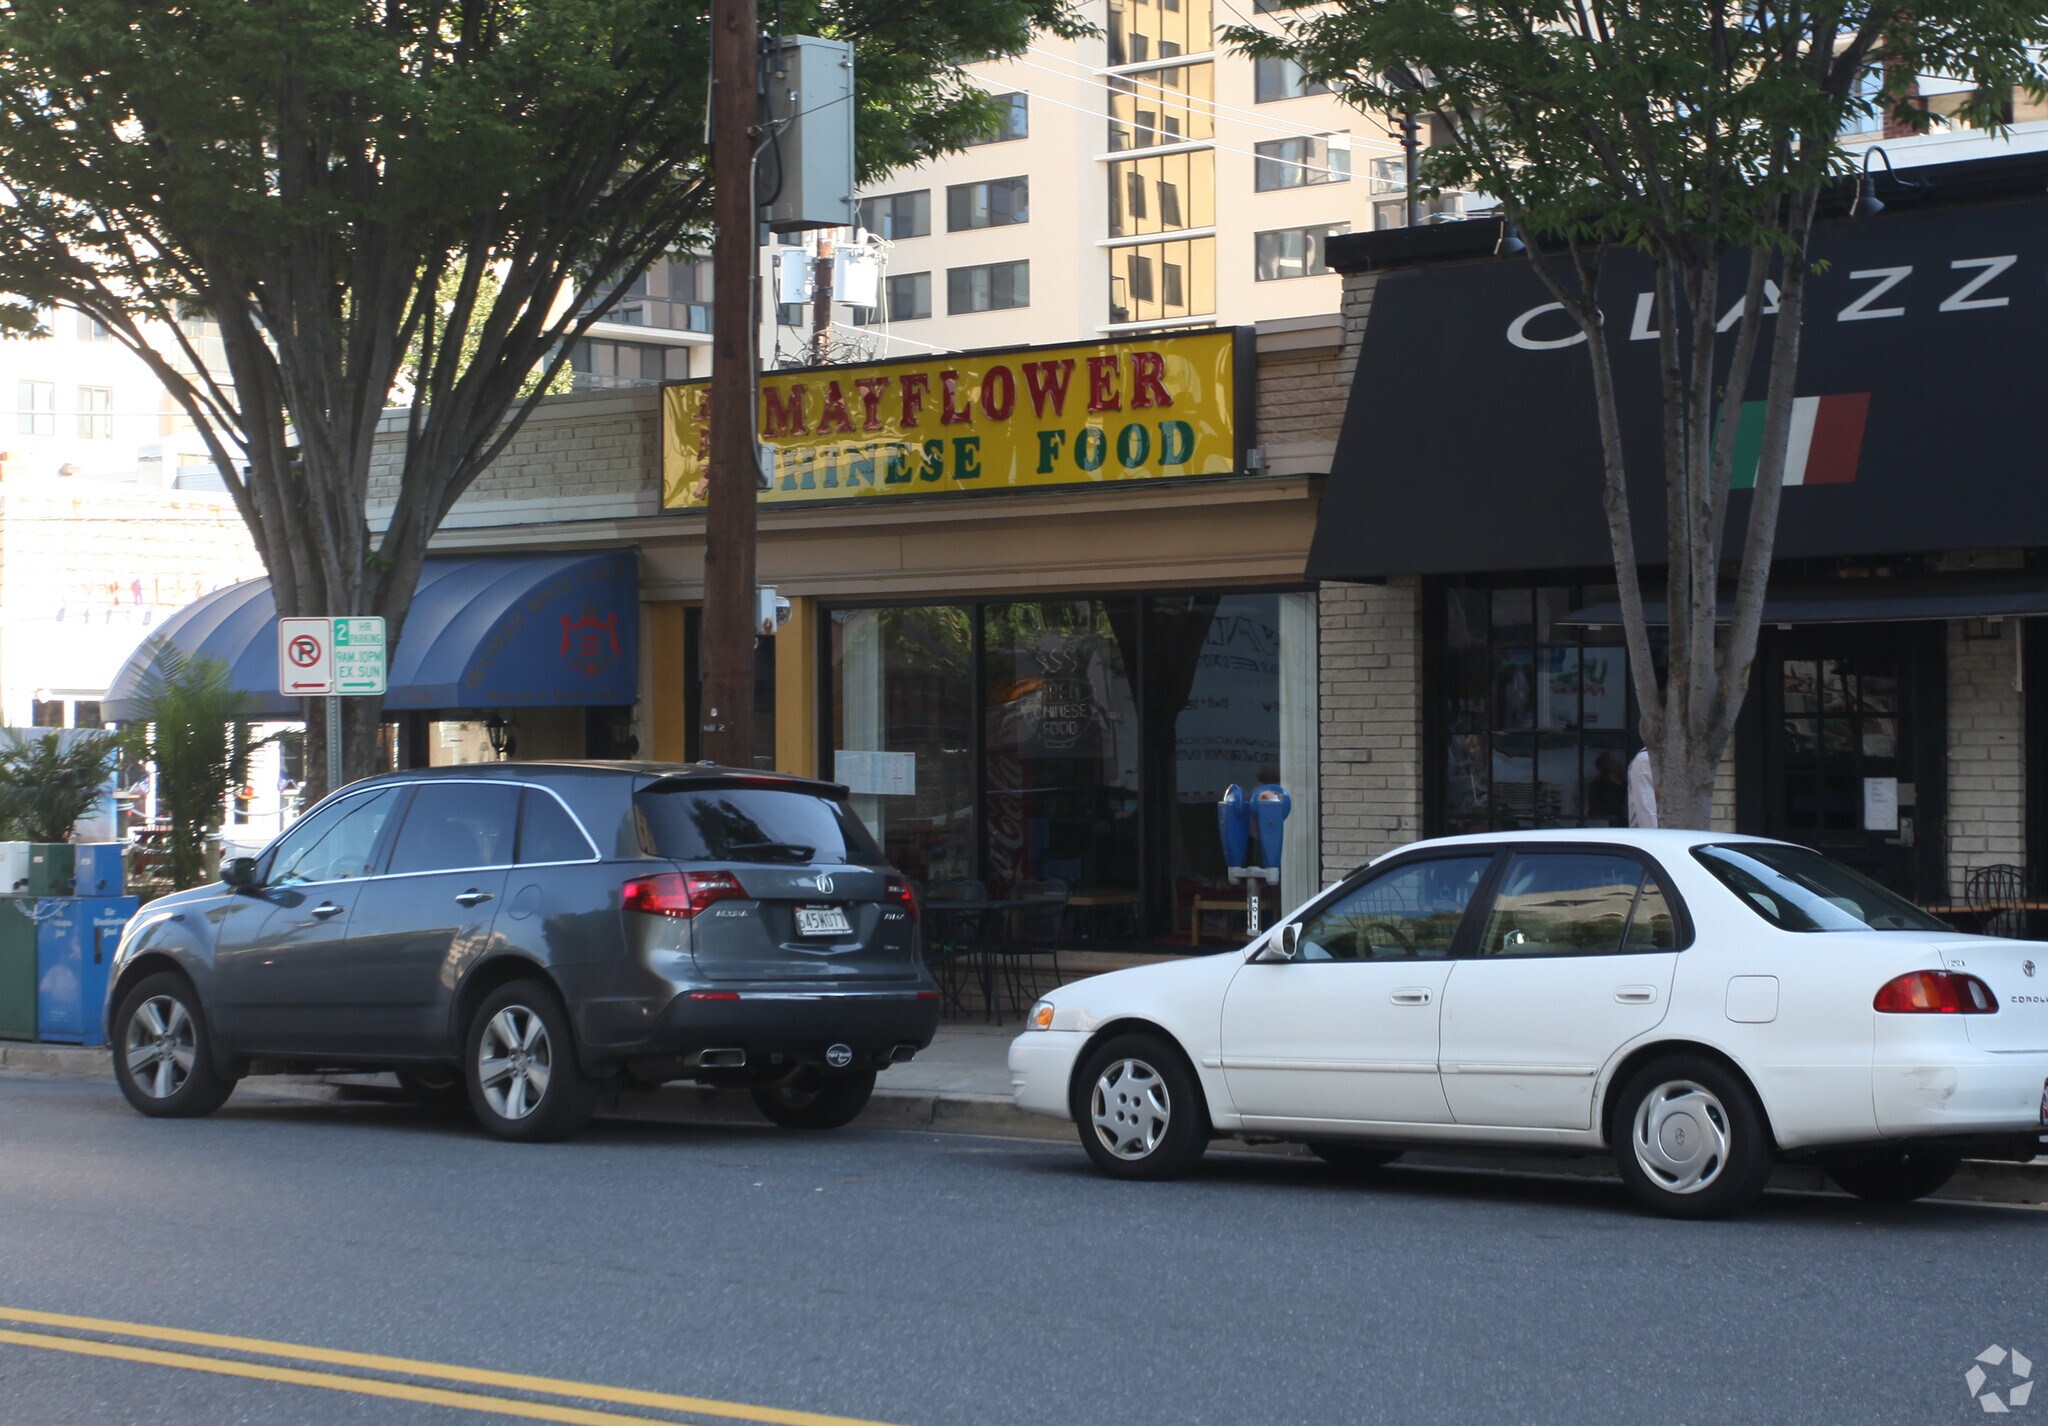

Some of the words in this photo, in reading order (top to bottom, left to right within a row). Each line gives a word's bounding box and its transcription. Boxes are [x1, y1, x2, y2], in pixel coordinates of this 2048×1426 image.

[762, 351, 1174, 437] MAYFLOWER
[772, 436, 981, 491] HINESE
[1036, 420, 1195, 474] FOOD
[336, 623, 347, 640] 2
[359, 622, 371, 631] HR
[350, 634, 381, 643] PARKING
[359, 666, 380, 677] SUN
[1033, 703, 1087, 720] CHINESE
[1042, 721, 1078, 736] FOOD
